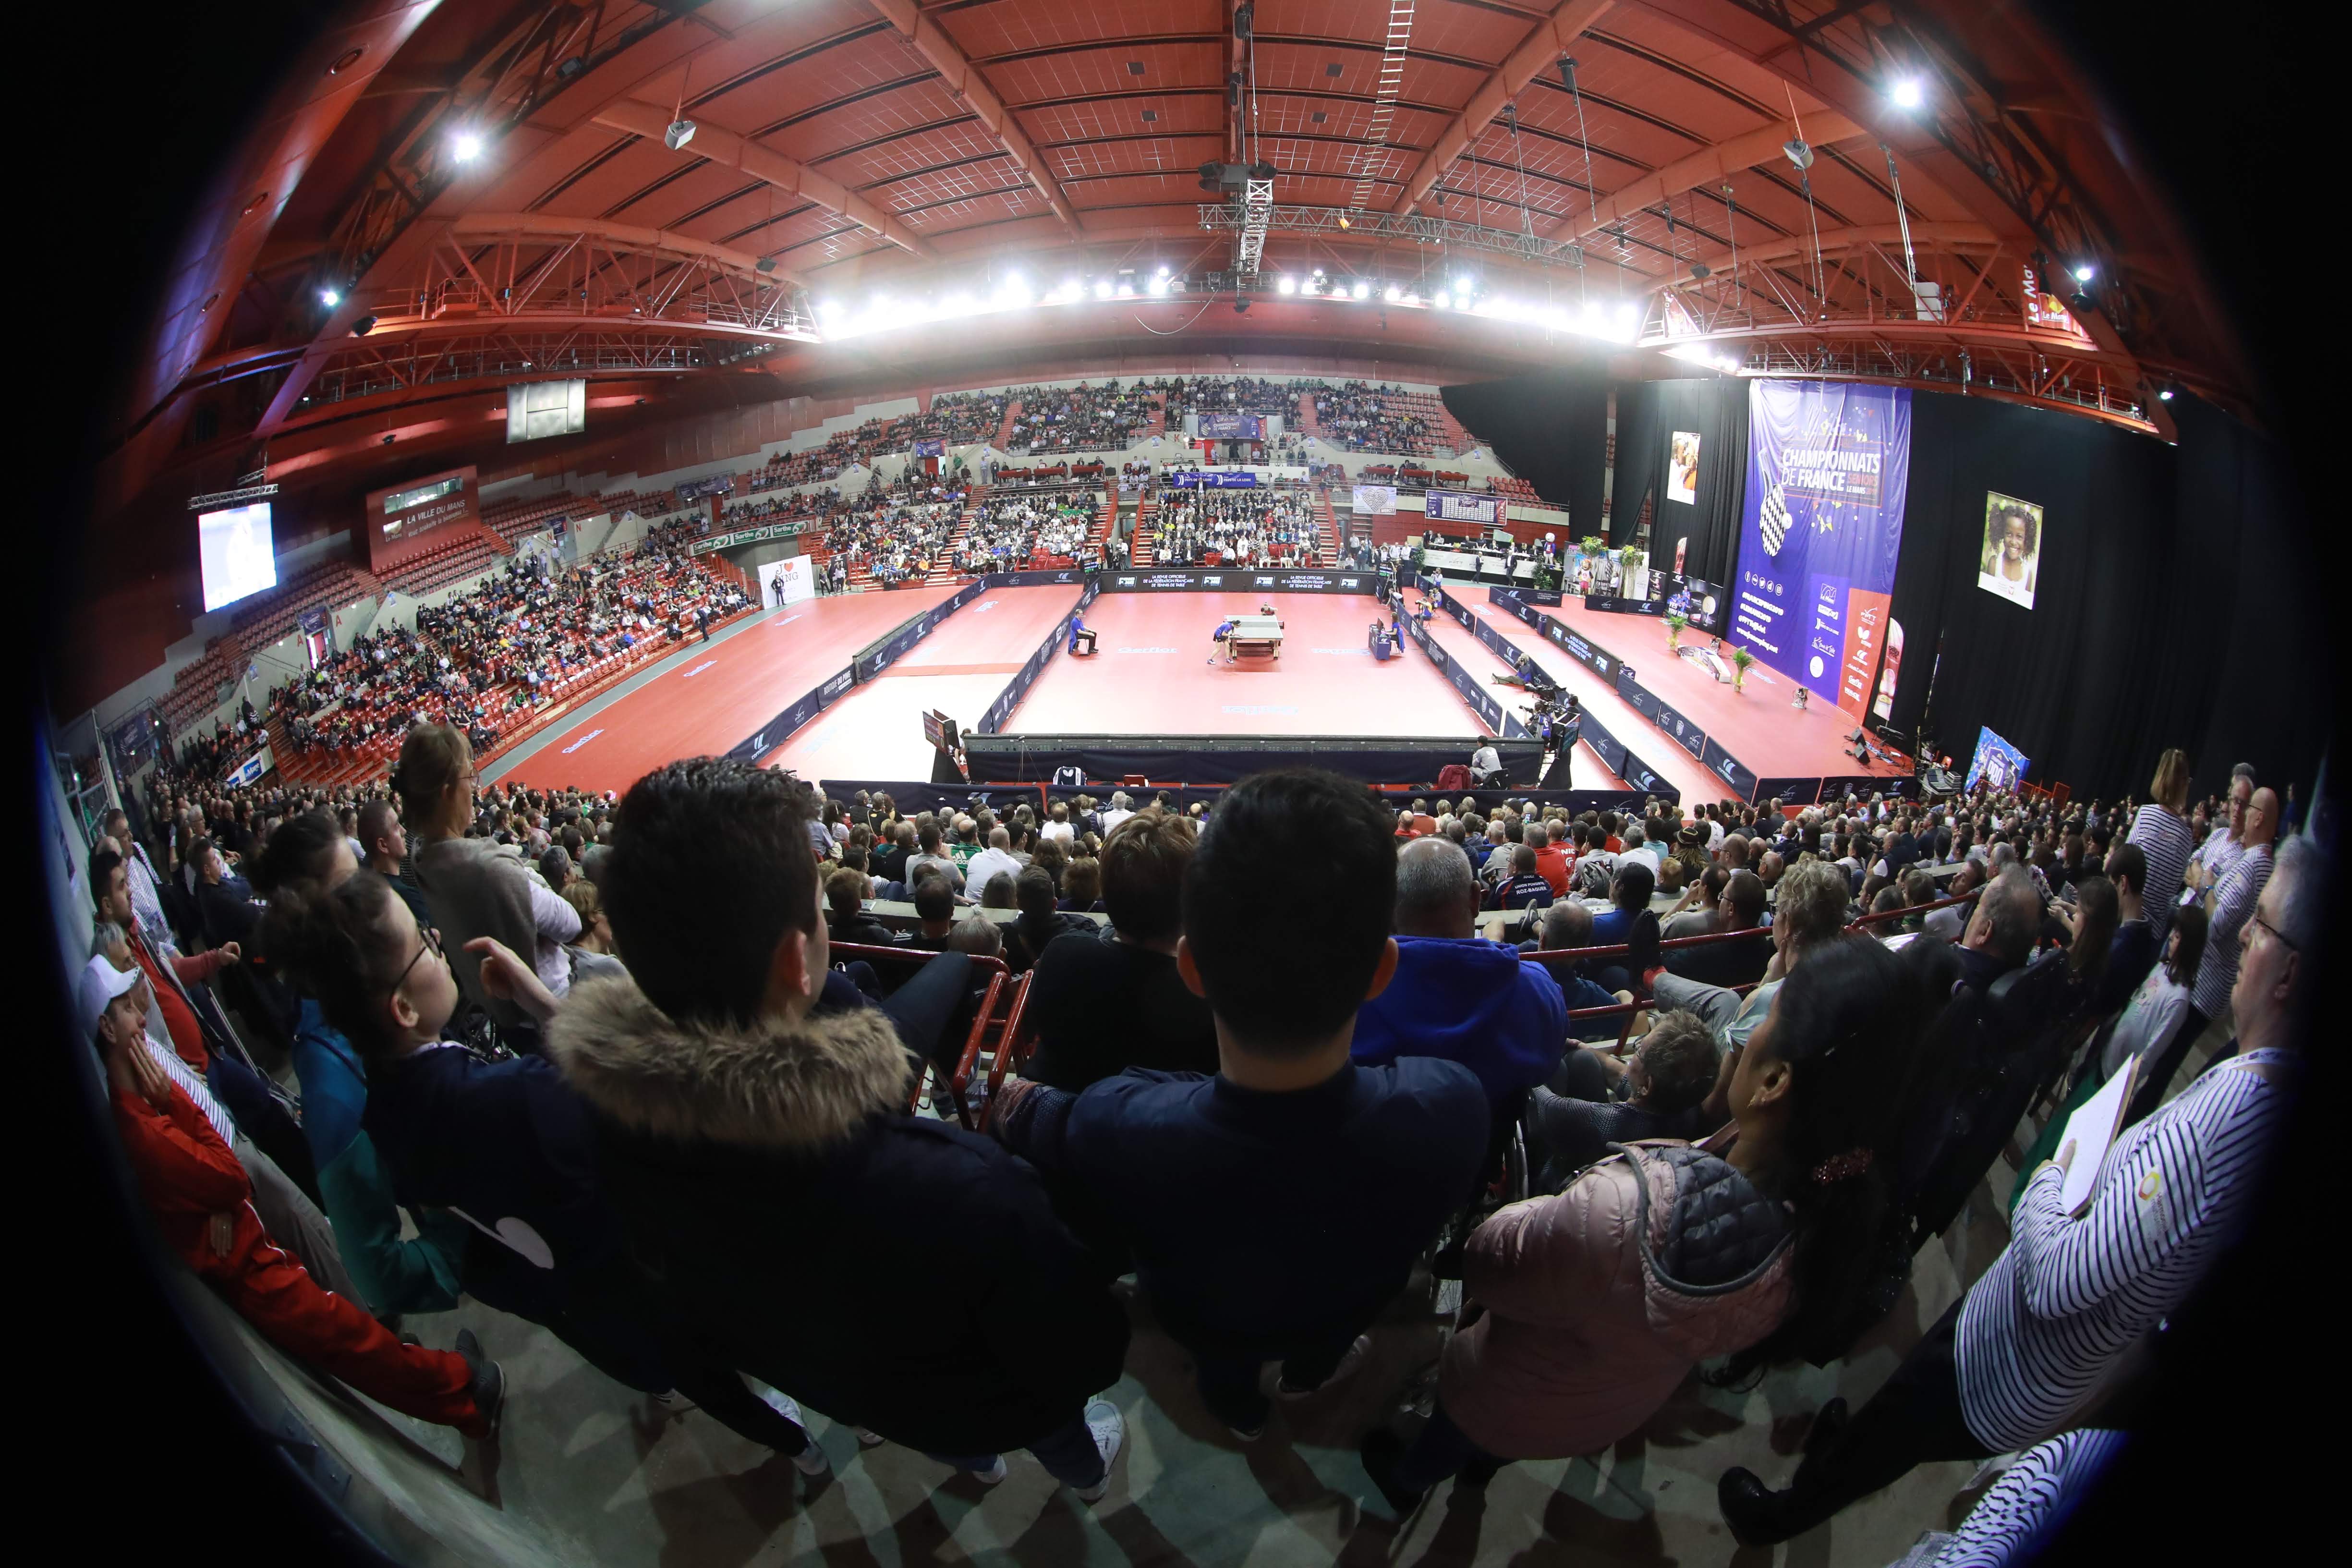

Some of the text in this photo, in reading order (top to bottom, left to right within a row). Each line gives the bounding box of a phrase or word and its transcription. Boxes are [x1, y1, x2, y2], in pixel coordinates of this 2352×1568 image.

[2028, 303, 2040, 323] Le
[2043, 311, 2050, 320] Le
[1782, 449, 1881, 474] CHAMPIONNATS
[1781, 467, 1846, 491] DE FRANCE
[407, 499, 465, 524] LA VILLE DU MANS
[774, 525, 791, 533] Sarthe
[547, 532, 552, 541] N
[735, 532, 754, 540] Sarthe
[776, 564, 784, 575] J
[781, 571, 798, 583] ING
[296, 634, 303, 646] A
[824, 680, 837, 695] BOUTIQUE
[837, 676, 843, 685] DU
[842, 670, 851, 682] PING
[1987, 760, 2003, 787] PRO
[1516, 886, 1547, 895] ROZ-BAGUER
